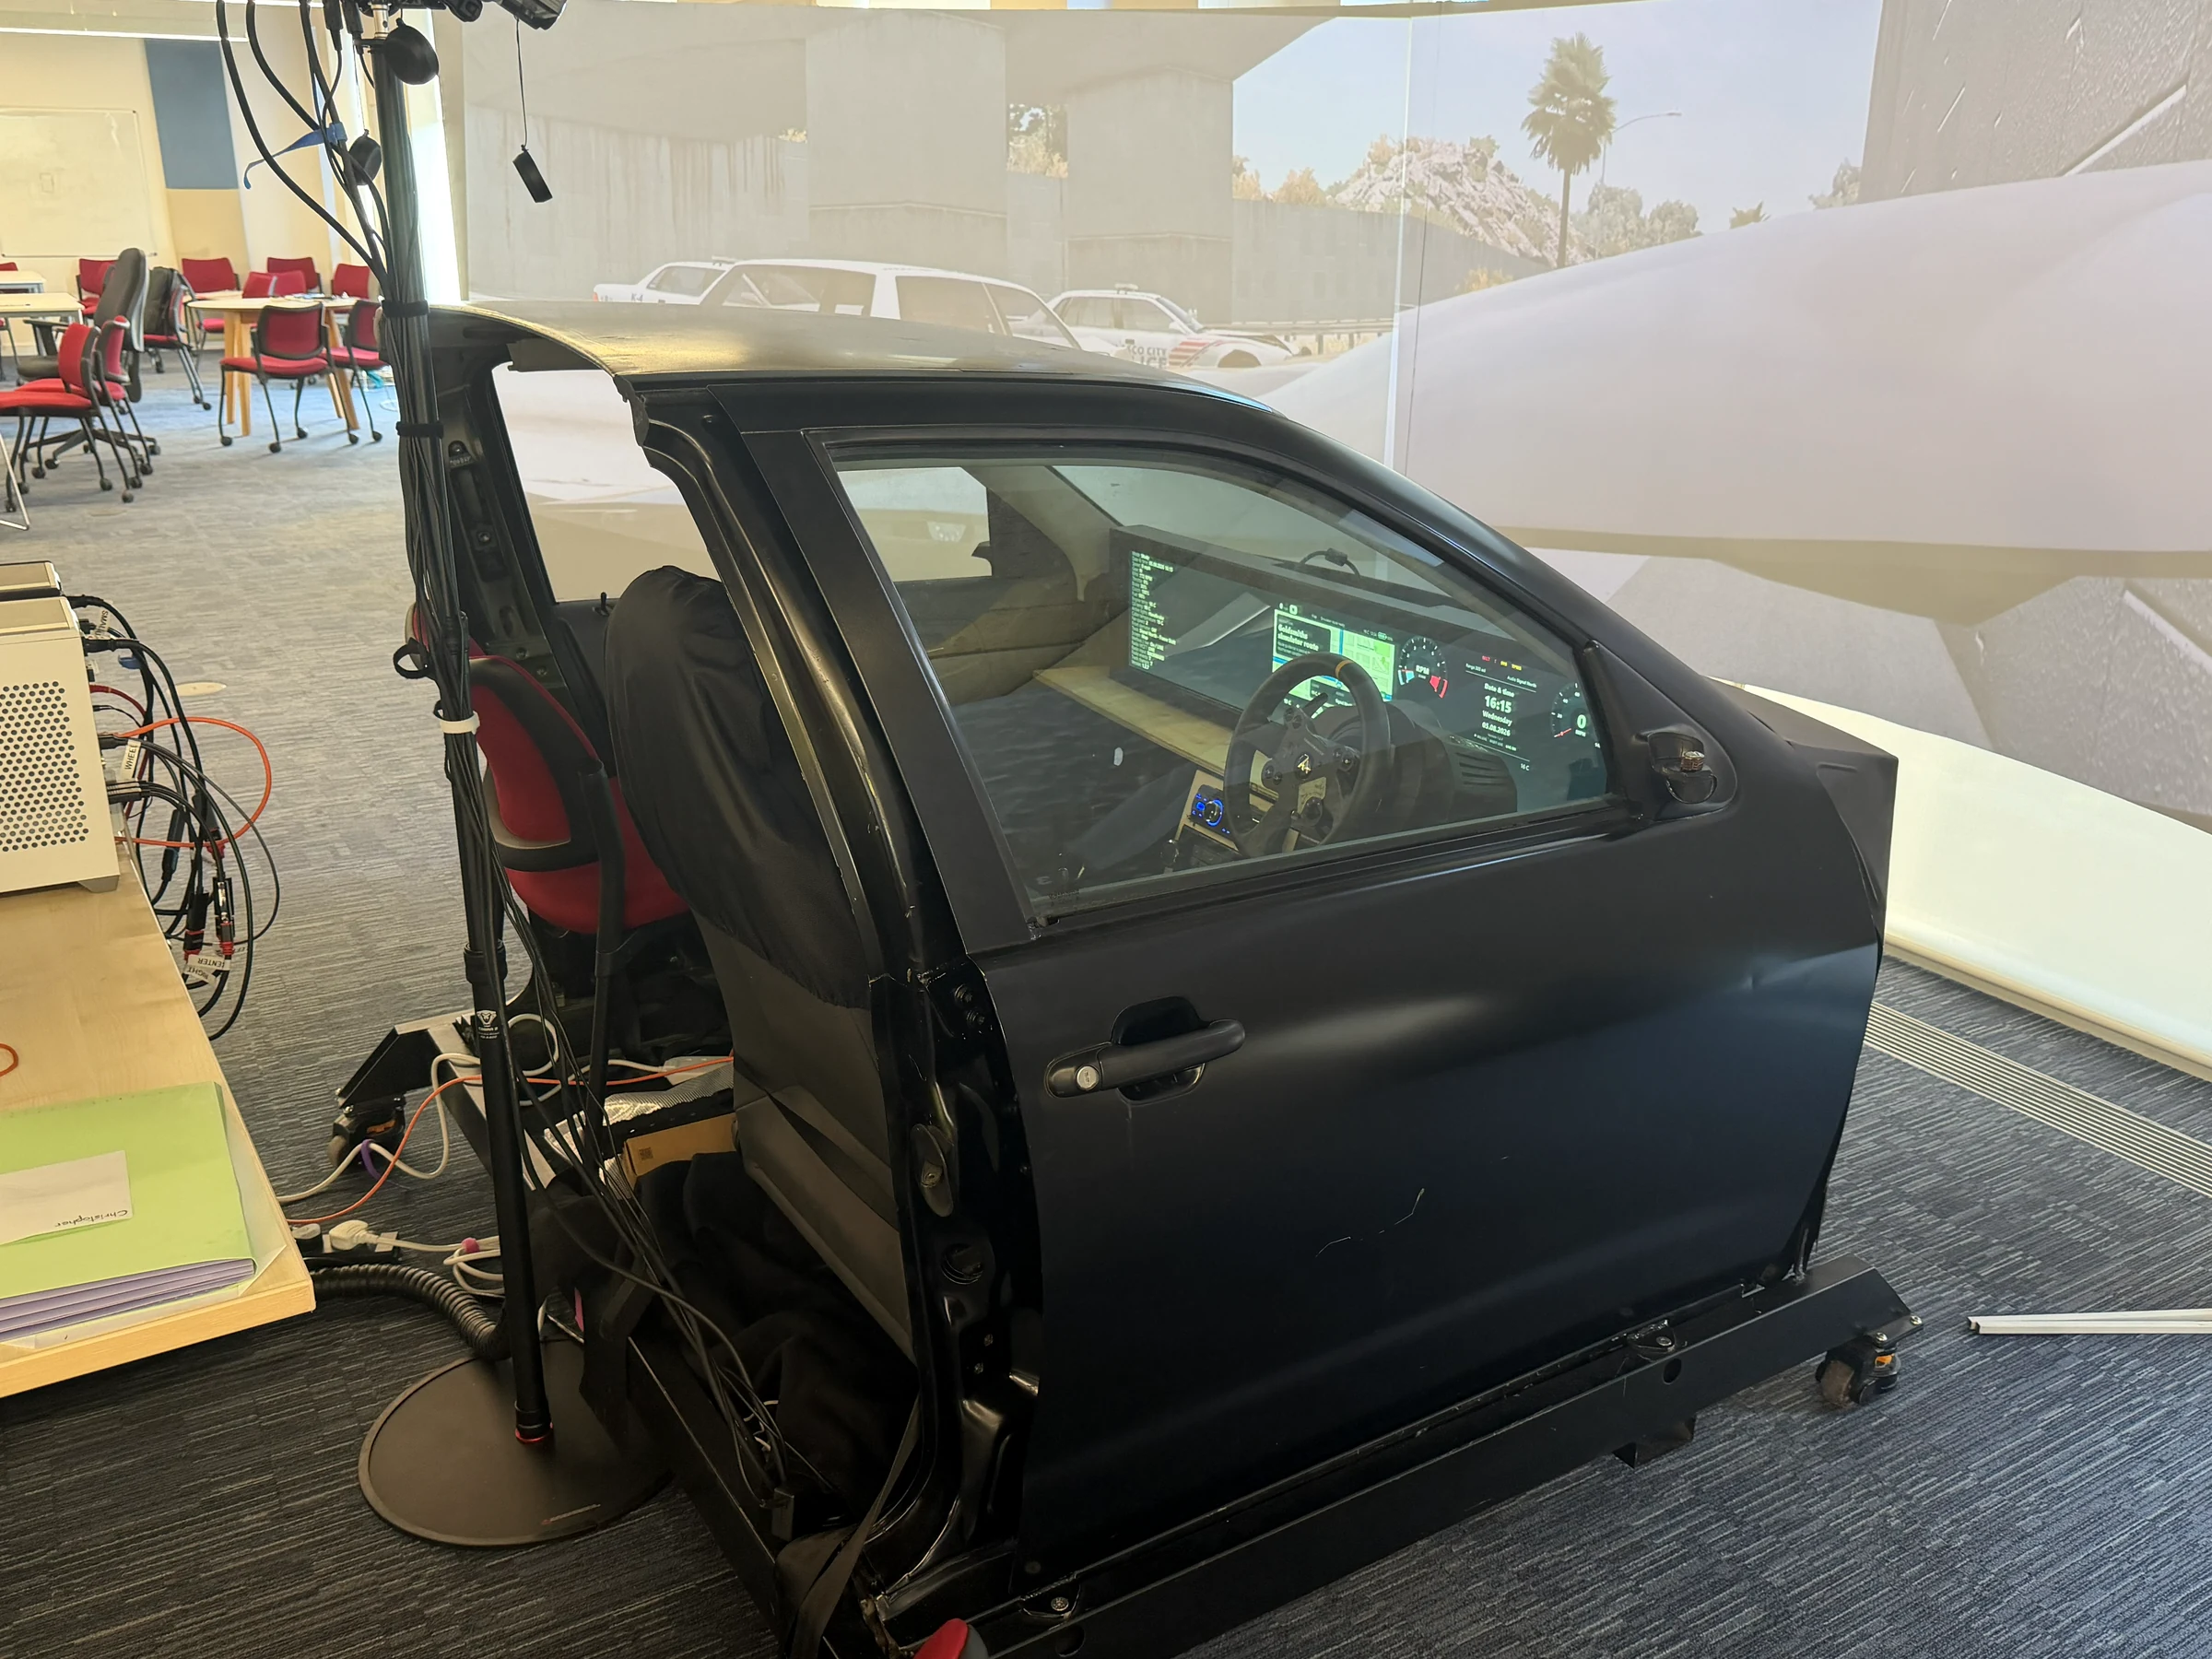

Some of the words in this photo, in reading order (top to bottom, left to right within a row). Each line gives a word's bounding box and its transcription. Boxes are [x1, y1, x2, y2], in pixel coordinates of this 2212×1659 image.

[1147, 347, 1166, 356] CITY
[1303, 641, 1319, 652] route
[1416, 665, 1430, 676] RPM
[1484, 683, 1497, 693] Date
[1502, 688, 1515, 698] time
[1485, 695, 1512, 713] 16:15
[1482, 710, 1512, 727] Wednesday
[1576, 714, 1587, 729] 0
[54, 1209, 128, 1228] Christopher
